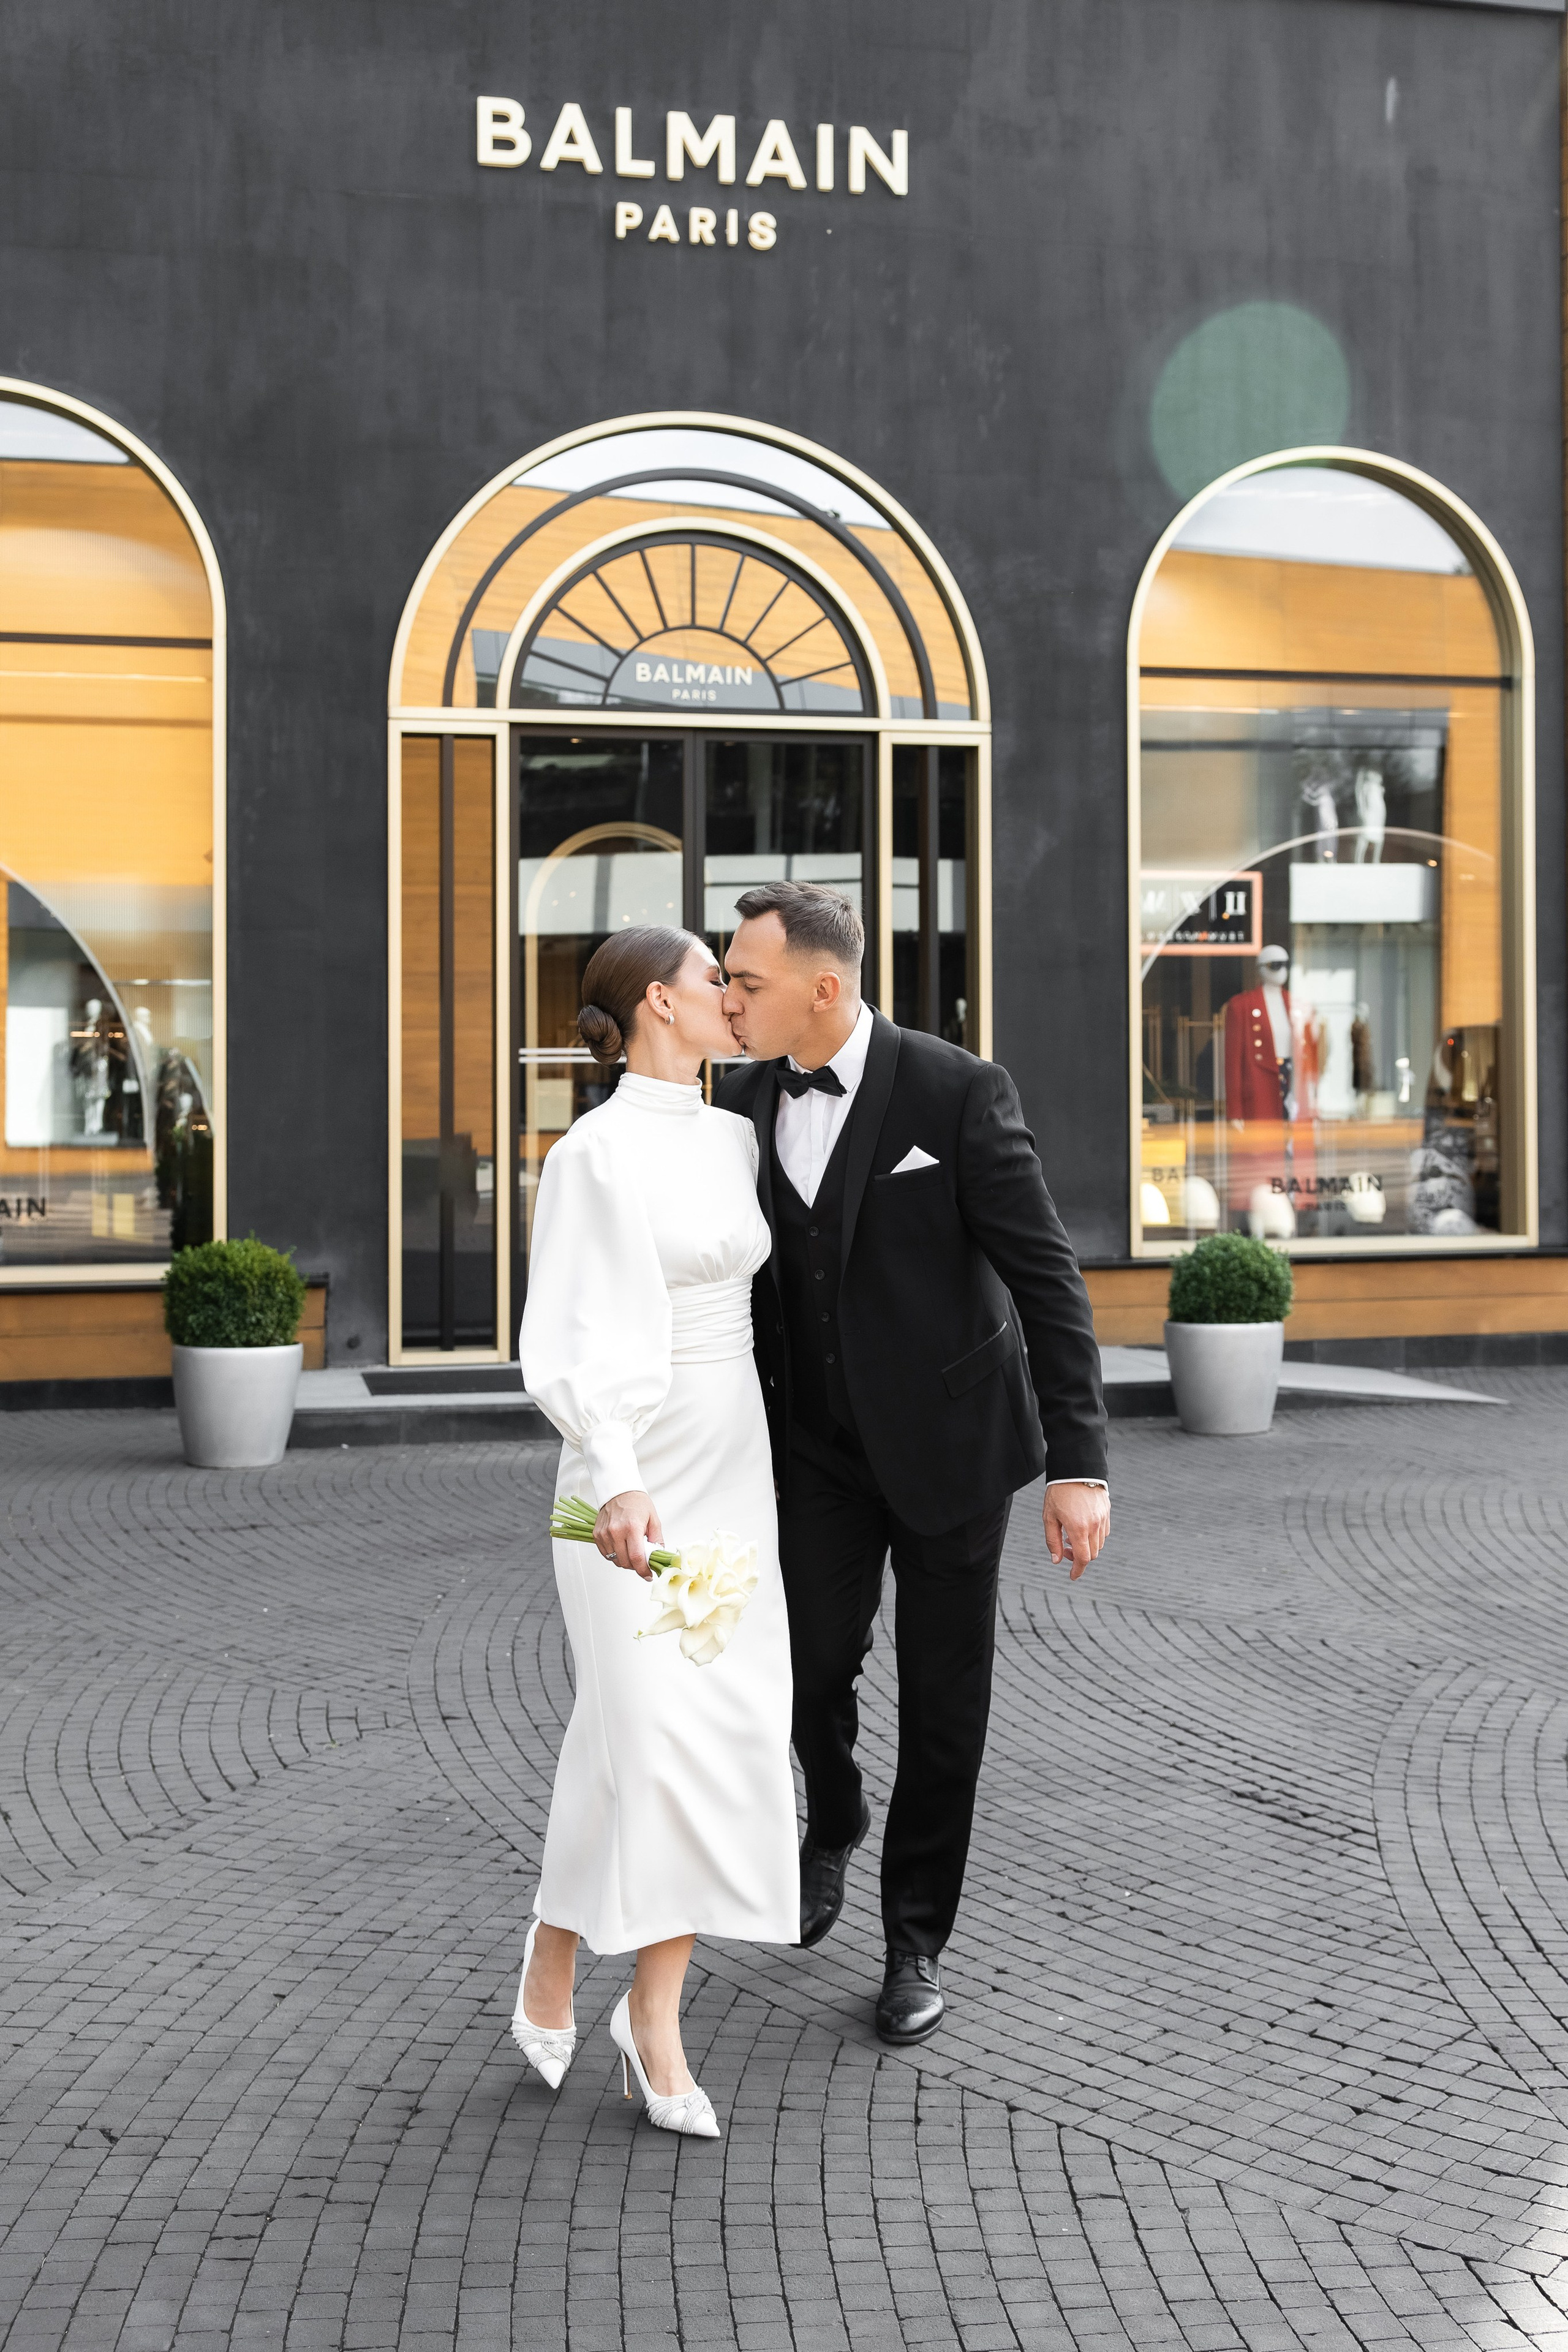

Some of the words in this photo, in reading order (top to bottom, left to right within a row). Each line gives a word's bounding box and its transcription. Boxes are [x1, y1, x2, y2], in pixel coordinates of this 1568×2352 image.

[476, 95, 908, 196] BALMAIN
[615, 202, 777, 250] PARIS
[635, 662, 753, 685] BALMAIN
[671, 688, 717, 701] PARIS
[1271, 1174, 1382, 1193] BALMAIN
